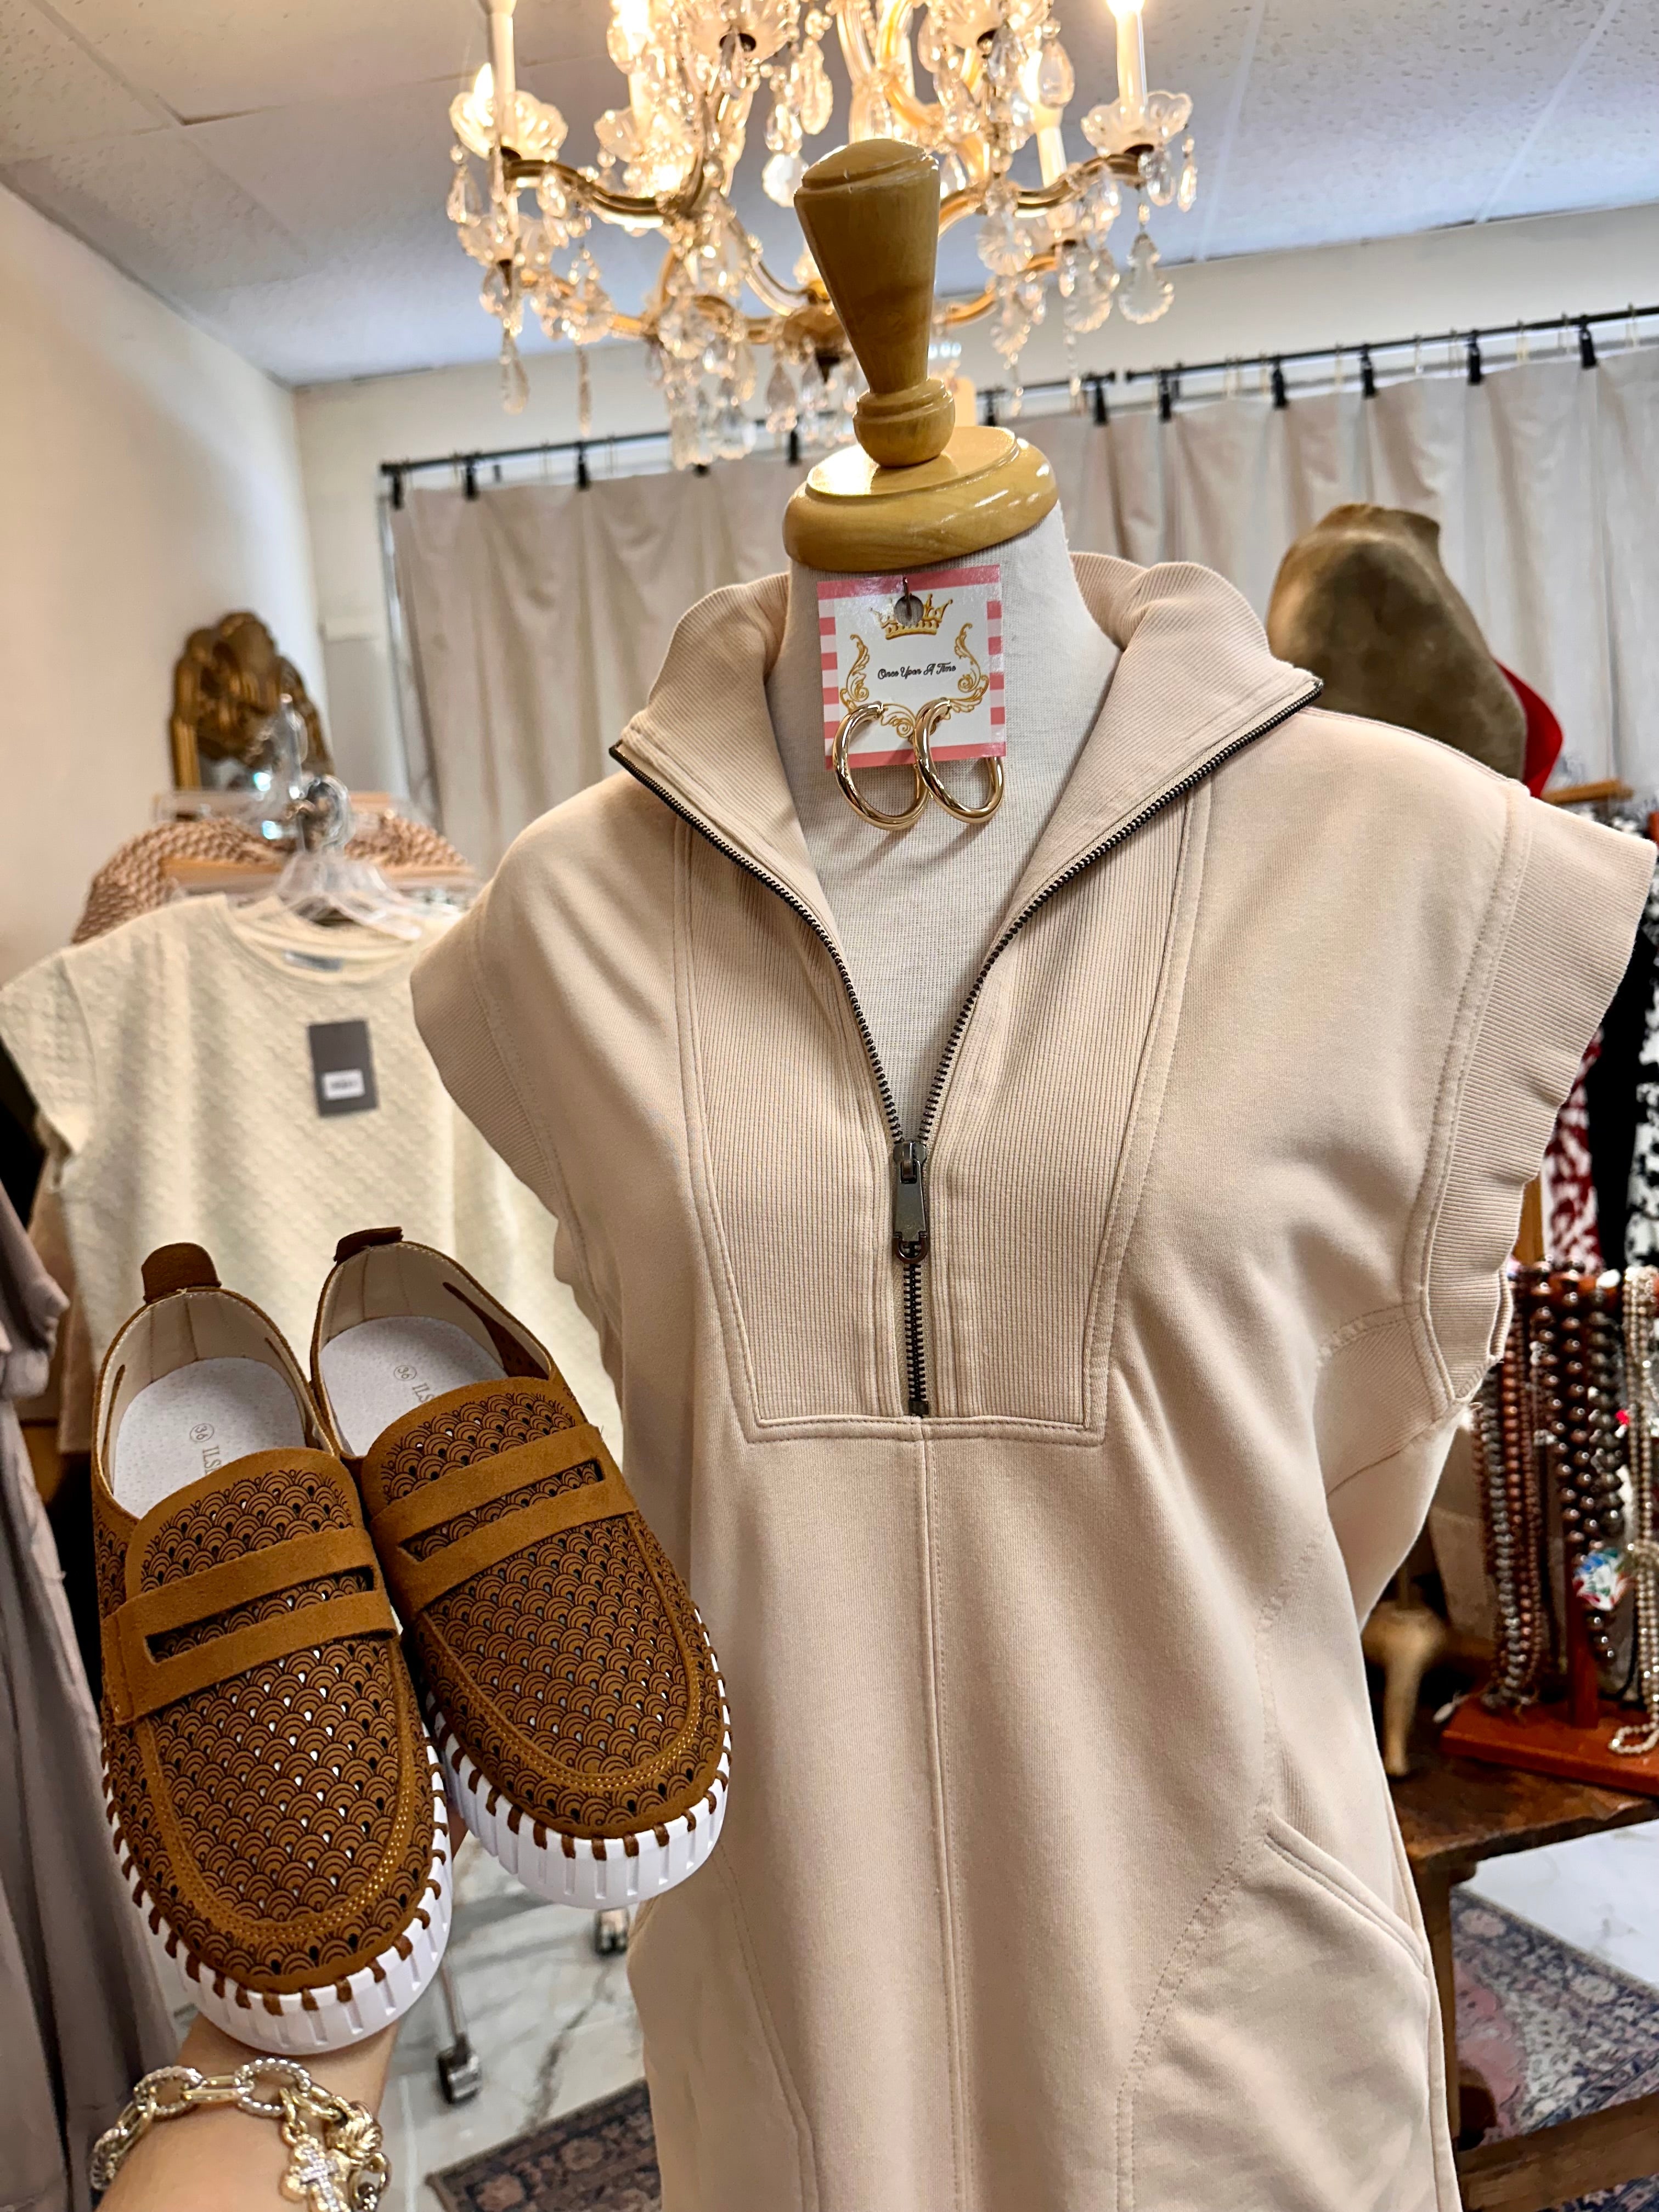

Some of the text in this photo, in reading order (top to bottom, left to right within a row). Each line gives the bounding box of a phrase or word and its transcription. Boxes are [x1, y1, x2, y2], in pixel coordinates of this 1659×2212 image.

[877, 662, 956, 680] Once Upon A Time
